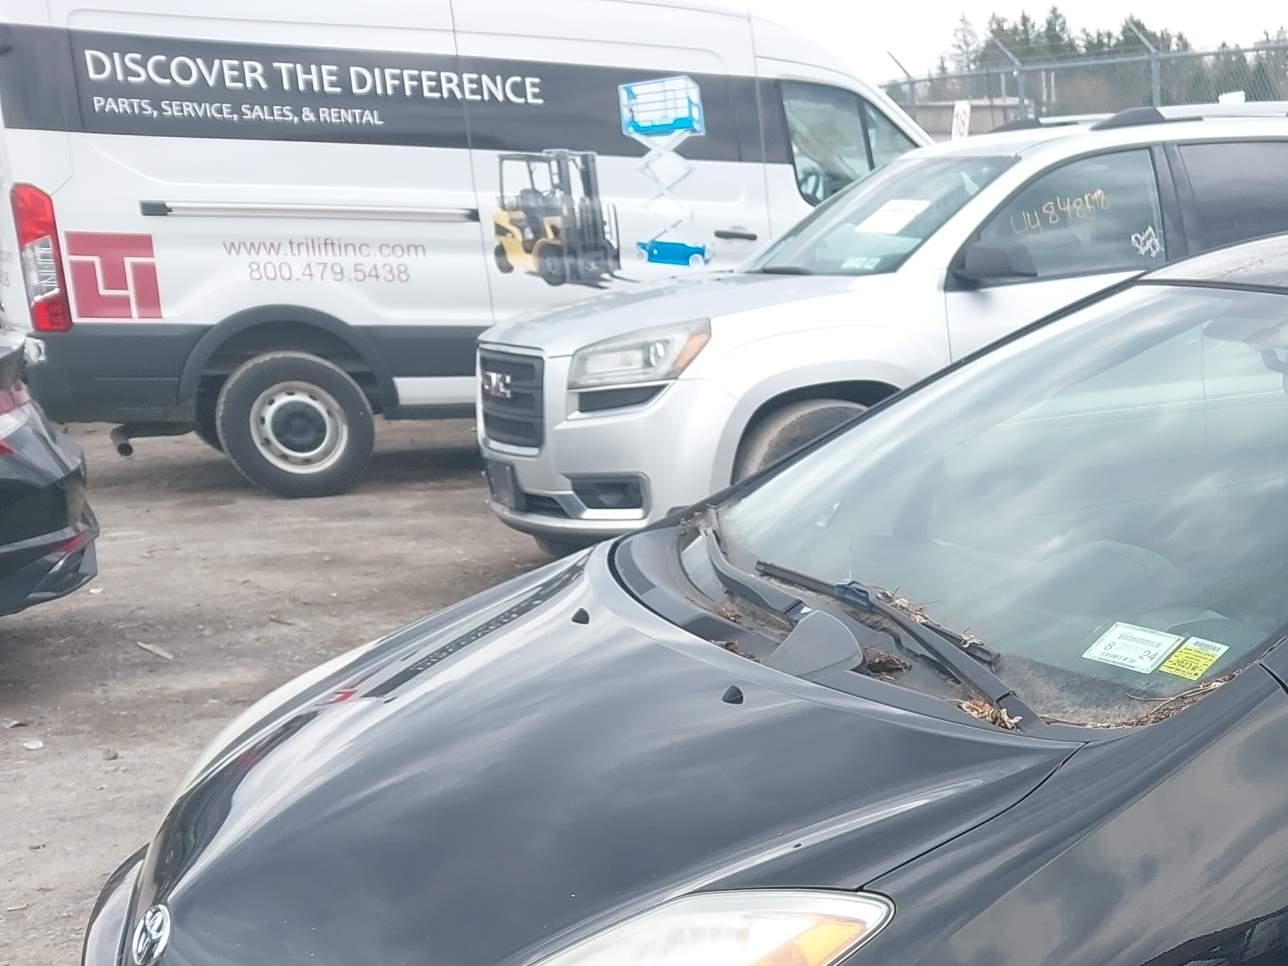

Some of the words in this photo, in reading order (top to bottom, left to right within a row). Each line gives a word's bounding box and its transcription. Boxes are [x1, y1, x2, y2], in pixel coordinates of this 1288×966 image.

[84, 49, 268, 91] DISCOVER
[273, 62, 342, 93] THE
[350, 66, 544, 105] DIFFERENCE
[93, 96, 158, 118] PARTS,
[161, 100, 238, 121] SERVICE,
[240, 104, 299, 124] SALES,
[302, 107, 317, 123] &
[319, 107, 384, 126] RENTAL
[222, 237, 427, 258] www.triliftinc.com
[248, 261, 411, 283] 800.479.5438
